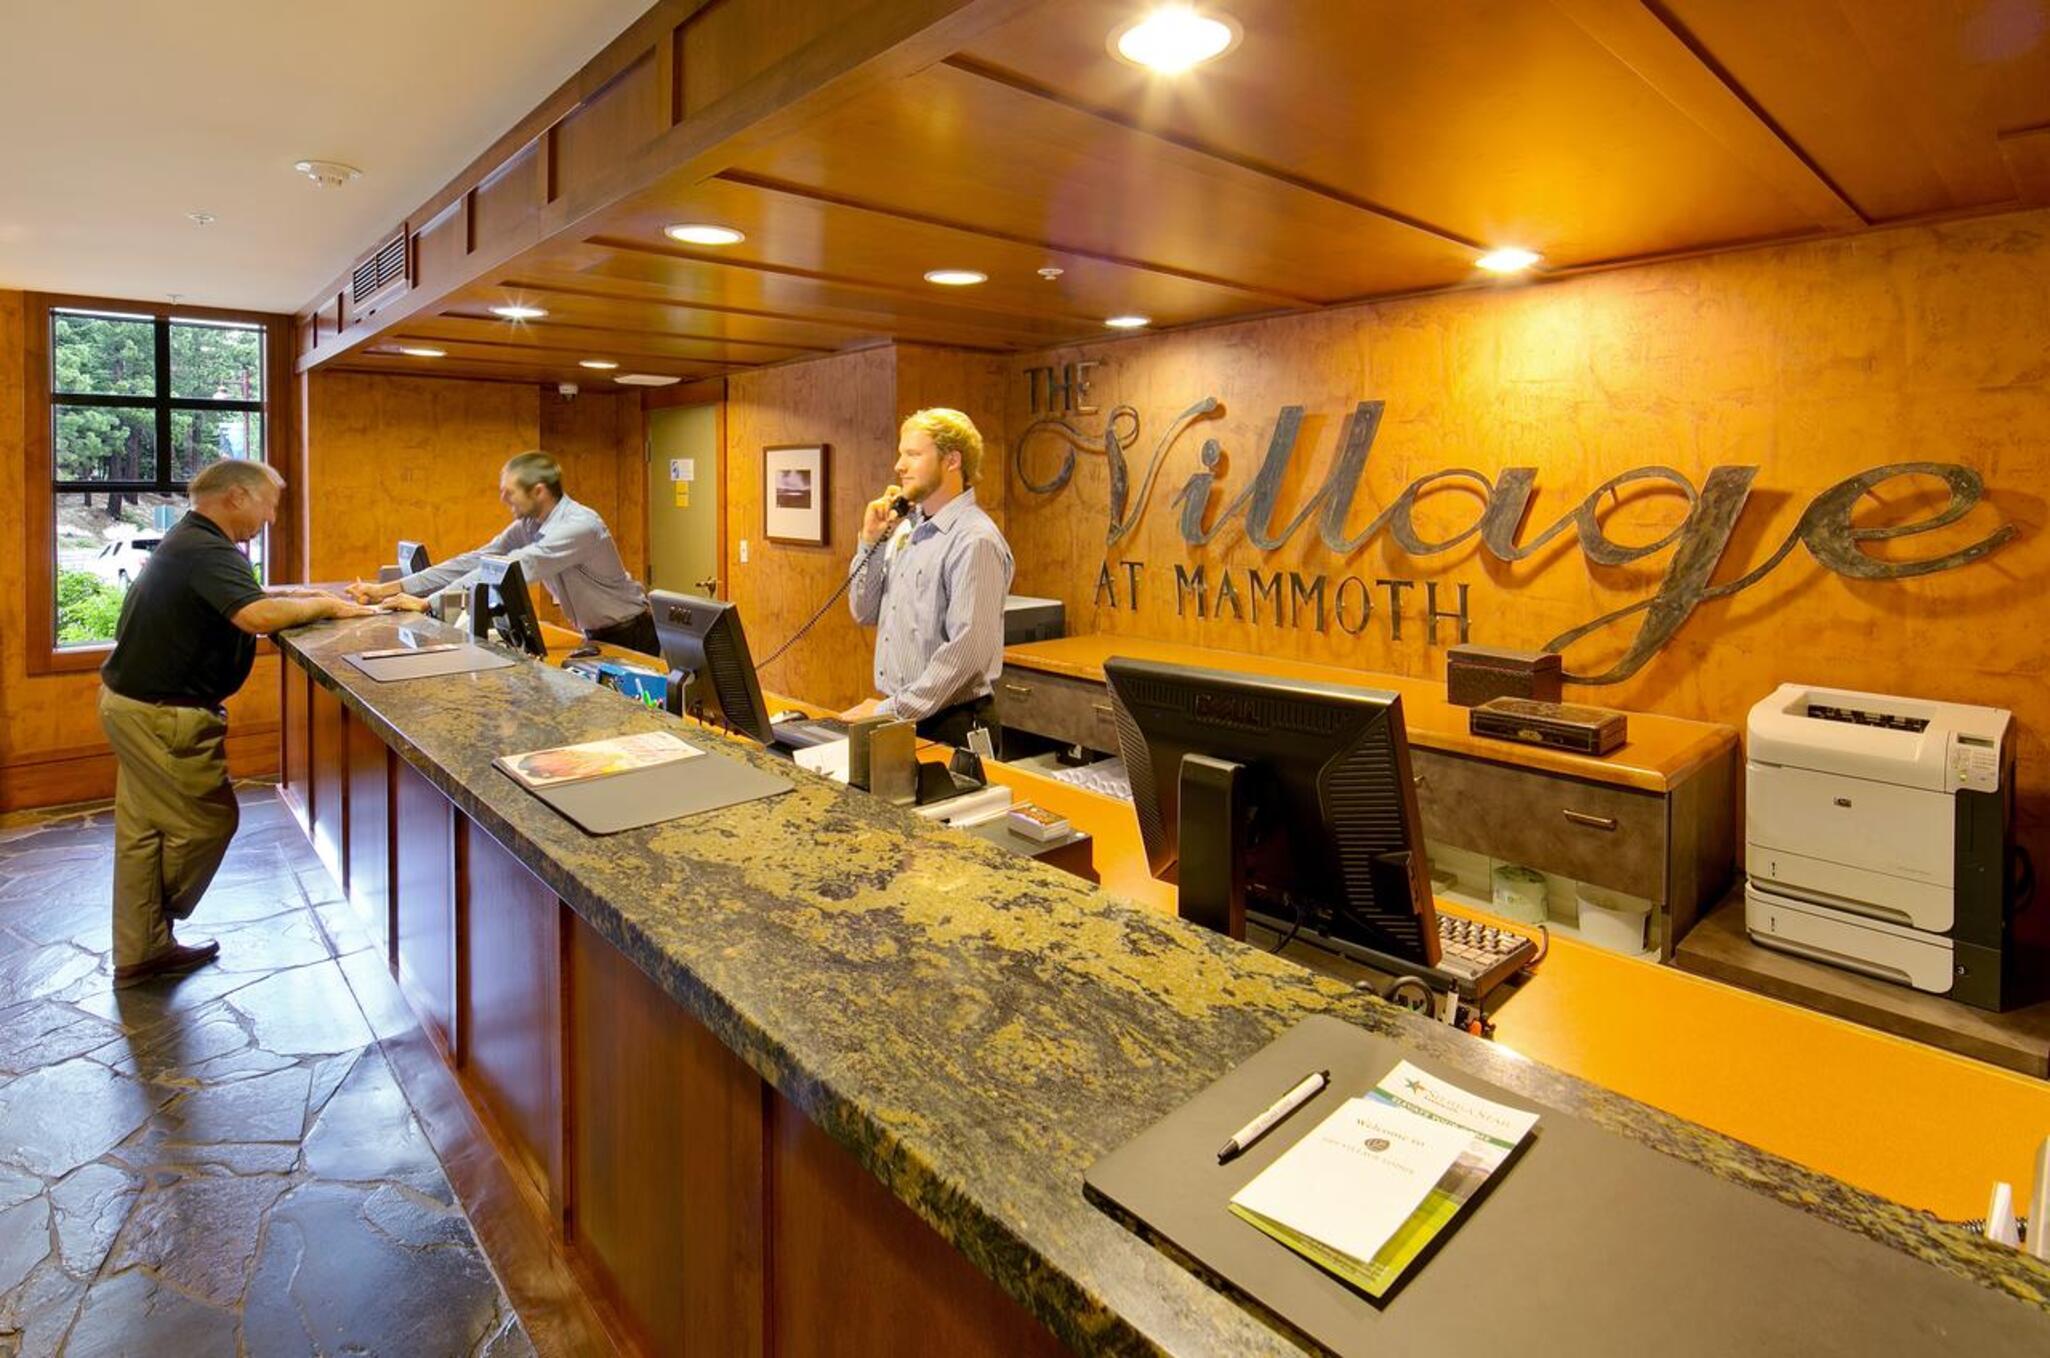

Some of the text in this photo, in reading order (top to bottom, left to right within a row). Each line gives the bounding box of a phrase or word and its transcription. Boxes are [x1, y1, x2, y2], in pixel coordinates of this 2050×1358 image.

[1024, 361, 1101, 415] THE
[1016, 396, 2019, 685] Village
[1094, 559, 1472, 645] AT MAMMOTH
